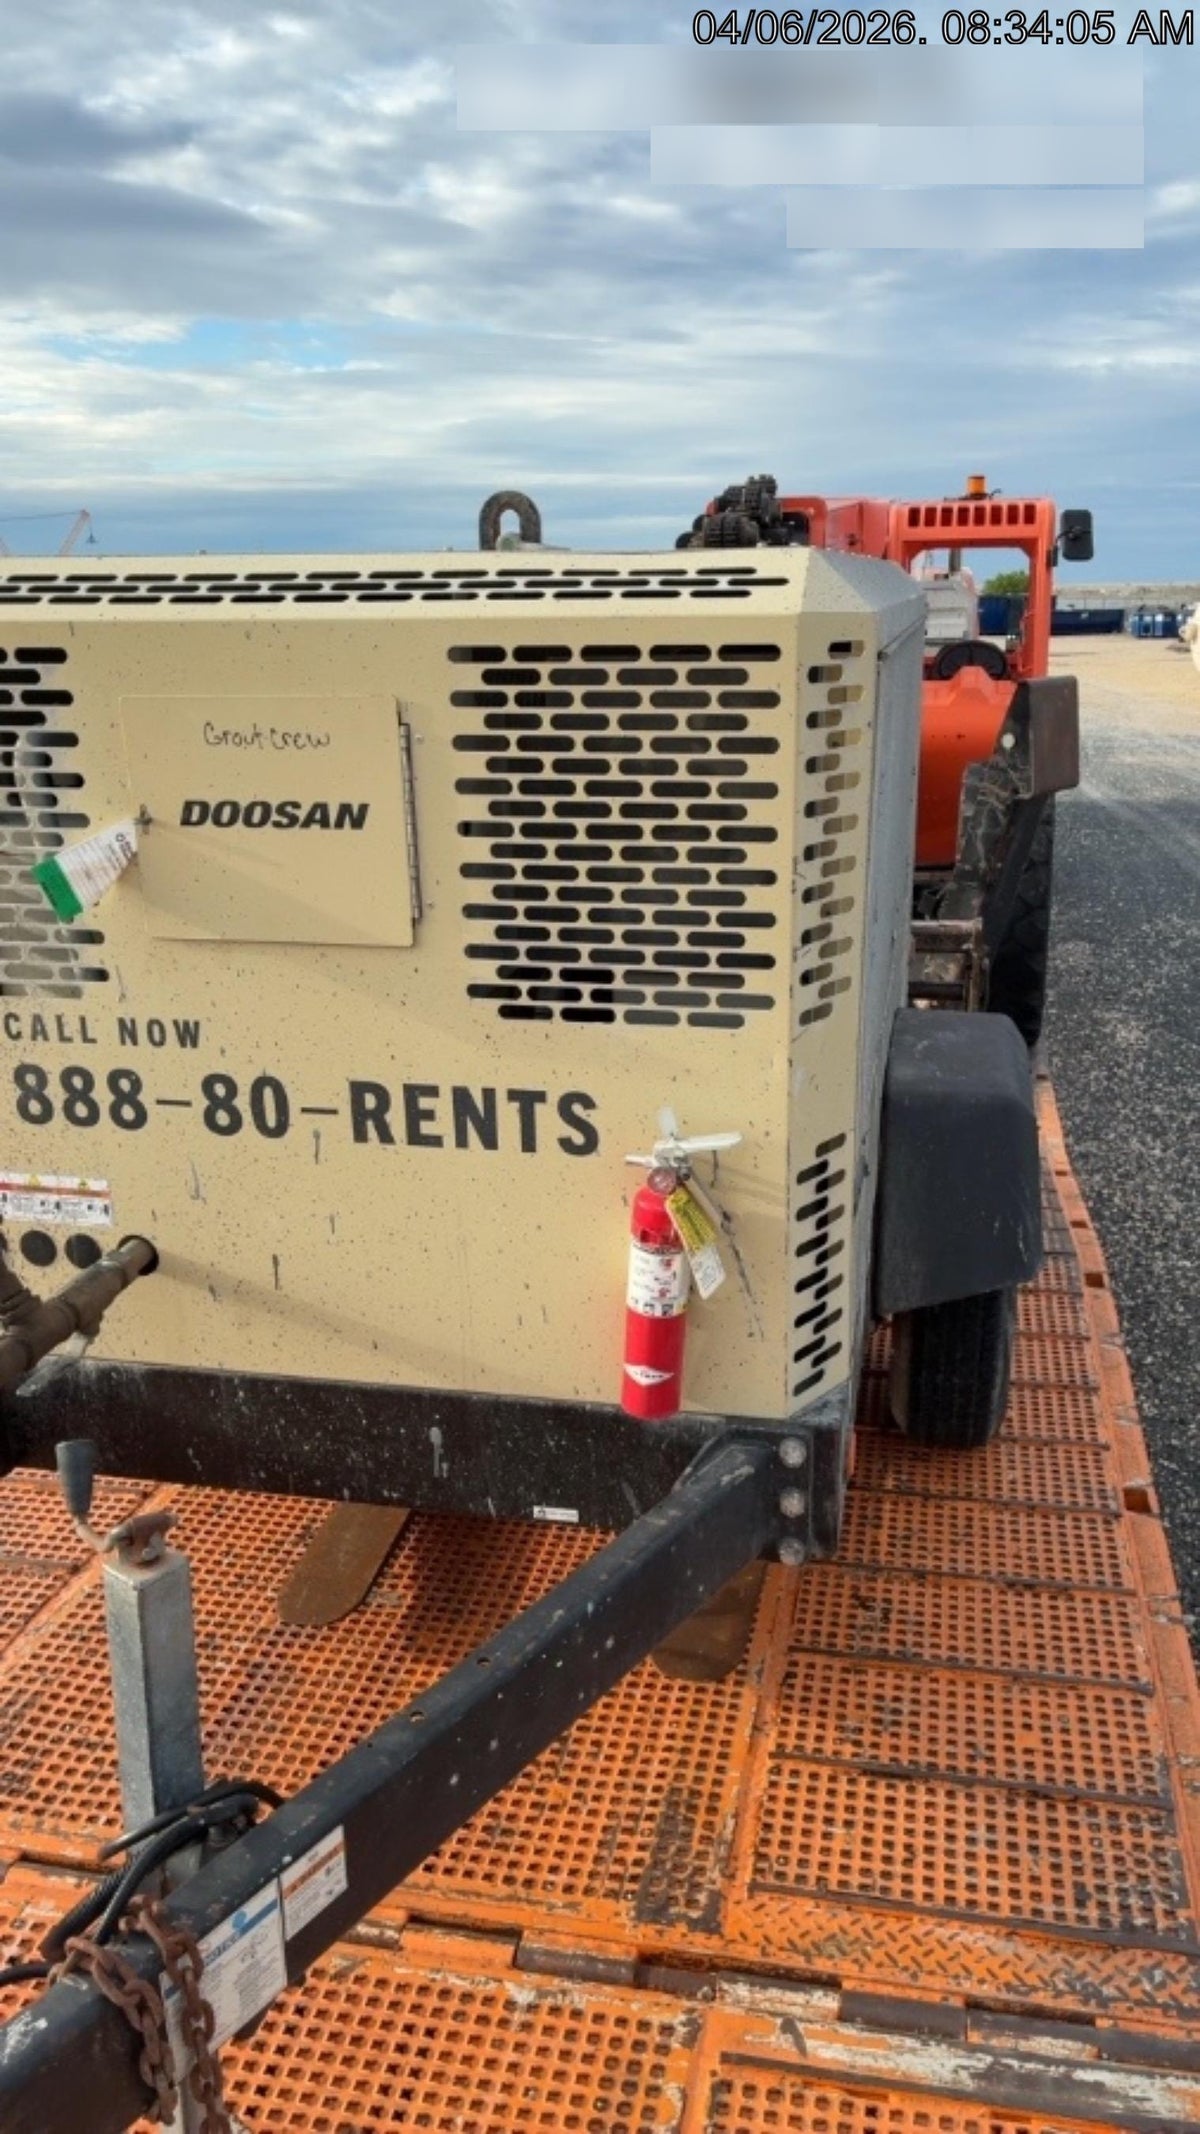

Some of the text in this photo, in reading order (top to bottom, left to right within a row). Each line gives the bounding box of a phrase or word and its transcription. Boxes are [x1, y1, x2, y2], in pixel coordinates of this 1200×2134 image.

[180, 799, 370, 830] DOOSAN
[4, 1012, 200, 1049] CALL NOW
[13, 1062, 600, 1157] 888-80-RENTS
